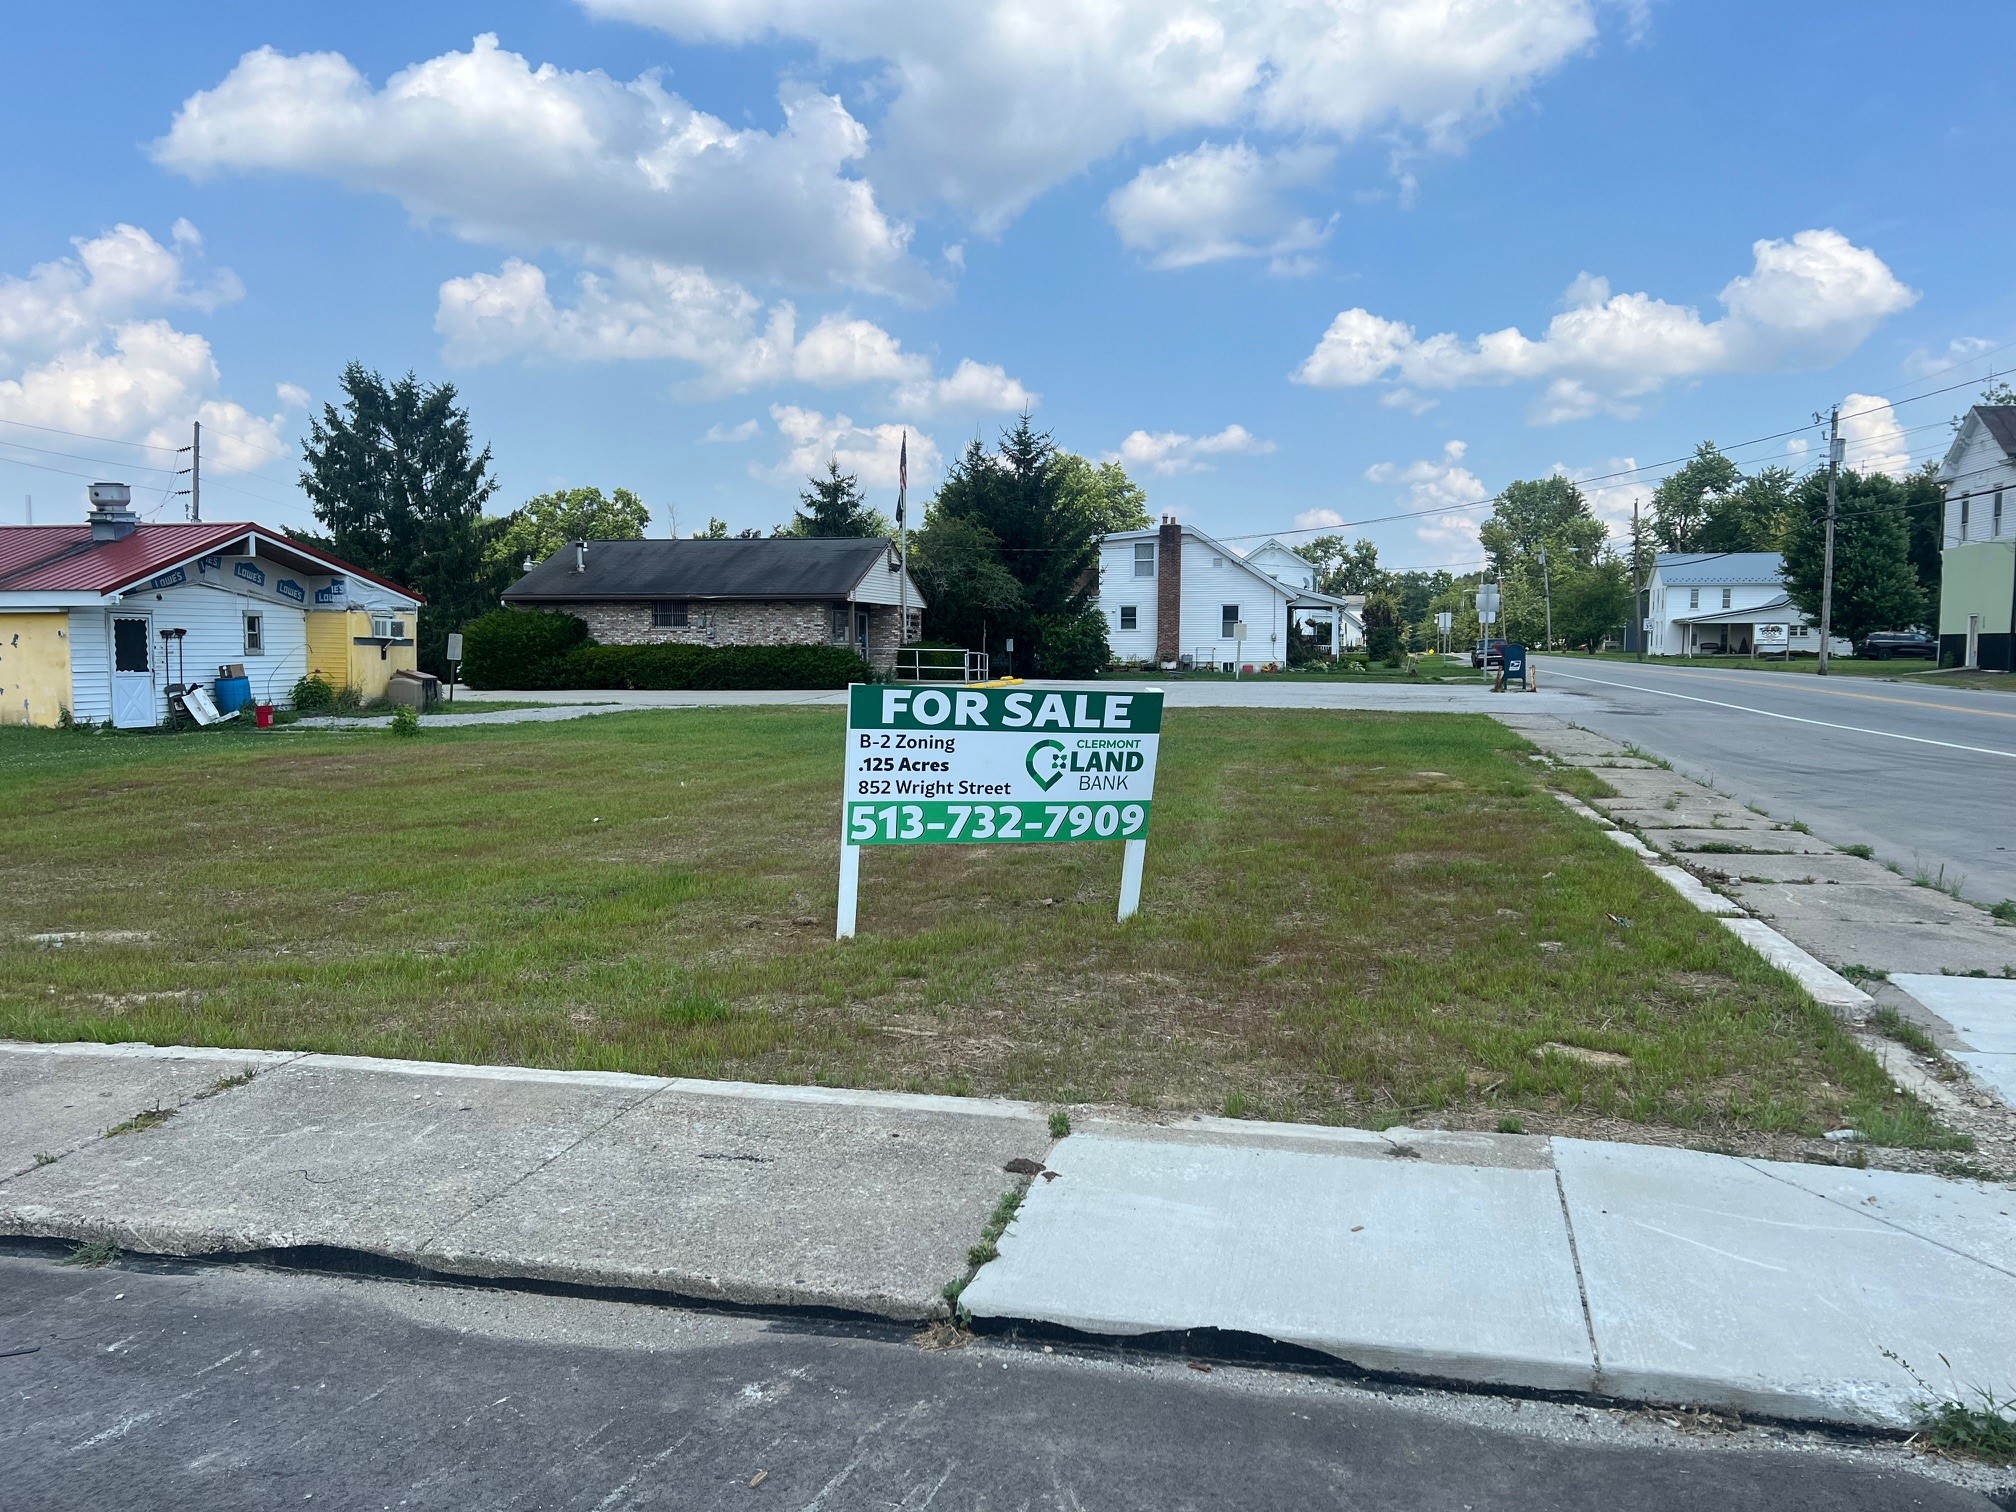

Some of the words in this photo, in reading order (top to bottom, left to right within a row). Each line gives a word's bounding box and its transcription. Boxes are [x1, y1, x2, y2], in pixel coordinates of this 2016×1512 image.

[237, 565, 262, 583] LOWE'S
[279, 582, 302, 600] LOWE'S
[881, 689, 989, 726] FOR
[1001, 692, 1133, 728] SALE
[860, 734, 890, 749] B-2
[895, 734, 955, 753] Zoning
[1076, 739, 1141, 749] CLERMONT
[858, 757, 894, 772] .125
[898, 757, 949, 772] Acres
[1070, 751, 1144, 772] LAND
[858, 780, 890, 795] 852
[895, 779, 953, 798] Wright
[958, 780, 1011, 795] Street
[1079, 775, 1128, 791] BANK
[851, 804, 1145, 840] 513-732-7909
